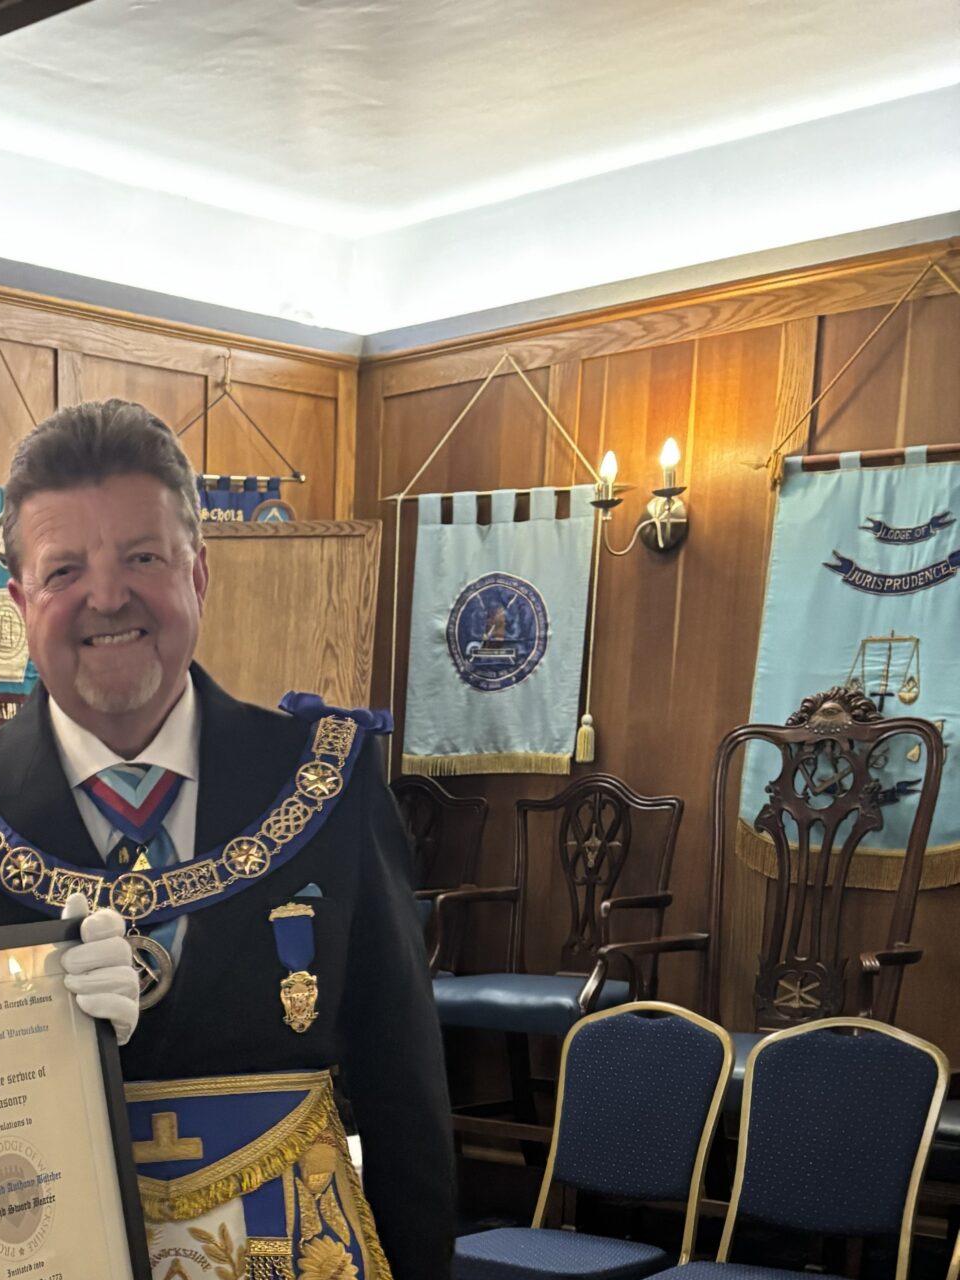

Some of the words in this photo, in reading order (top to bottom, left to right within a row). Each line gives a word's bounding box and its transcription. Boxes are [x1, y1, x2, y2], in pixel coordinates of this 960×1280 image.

[881, 529, 912, 540] LODGE
[914, 525, 929, 537] OF
[848, 563, 950, 591] JURISPRUDENCE
[0, 1030, 5, 1039] of
[6, 1024, 49, 1039] Warwickshire
[7, 1070, 36, 1085] service
[38, 1065, 46, 1078] of
[26, 1117, 33, 1126] to
[8, 1201, 32, 1215] Sword
[7, 1264, 32, 1278] Initiated
[33, 1261, 45, 1271] into
